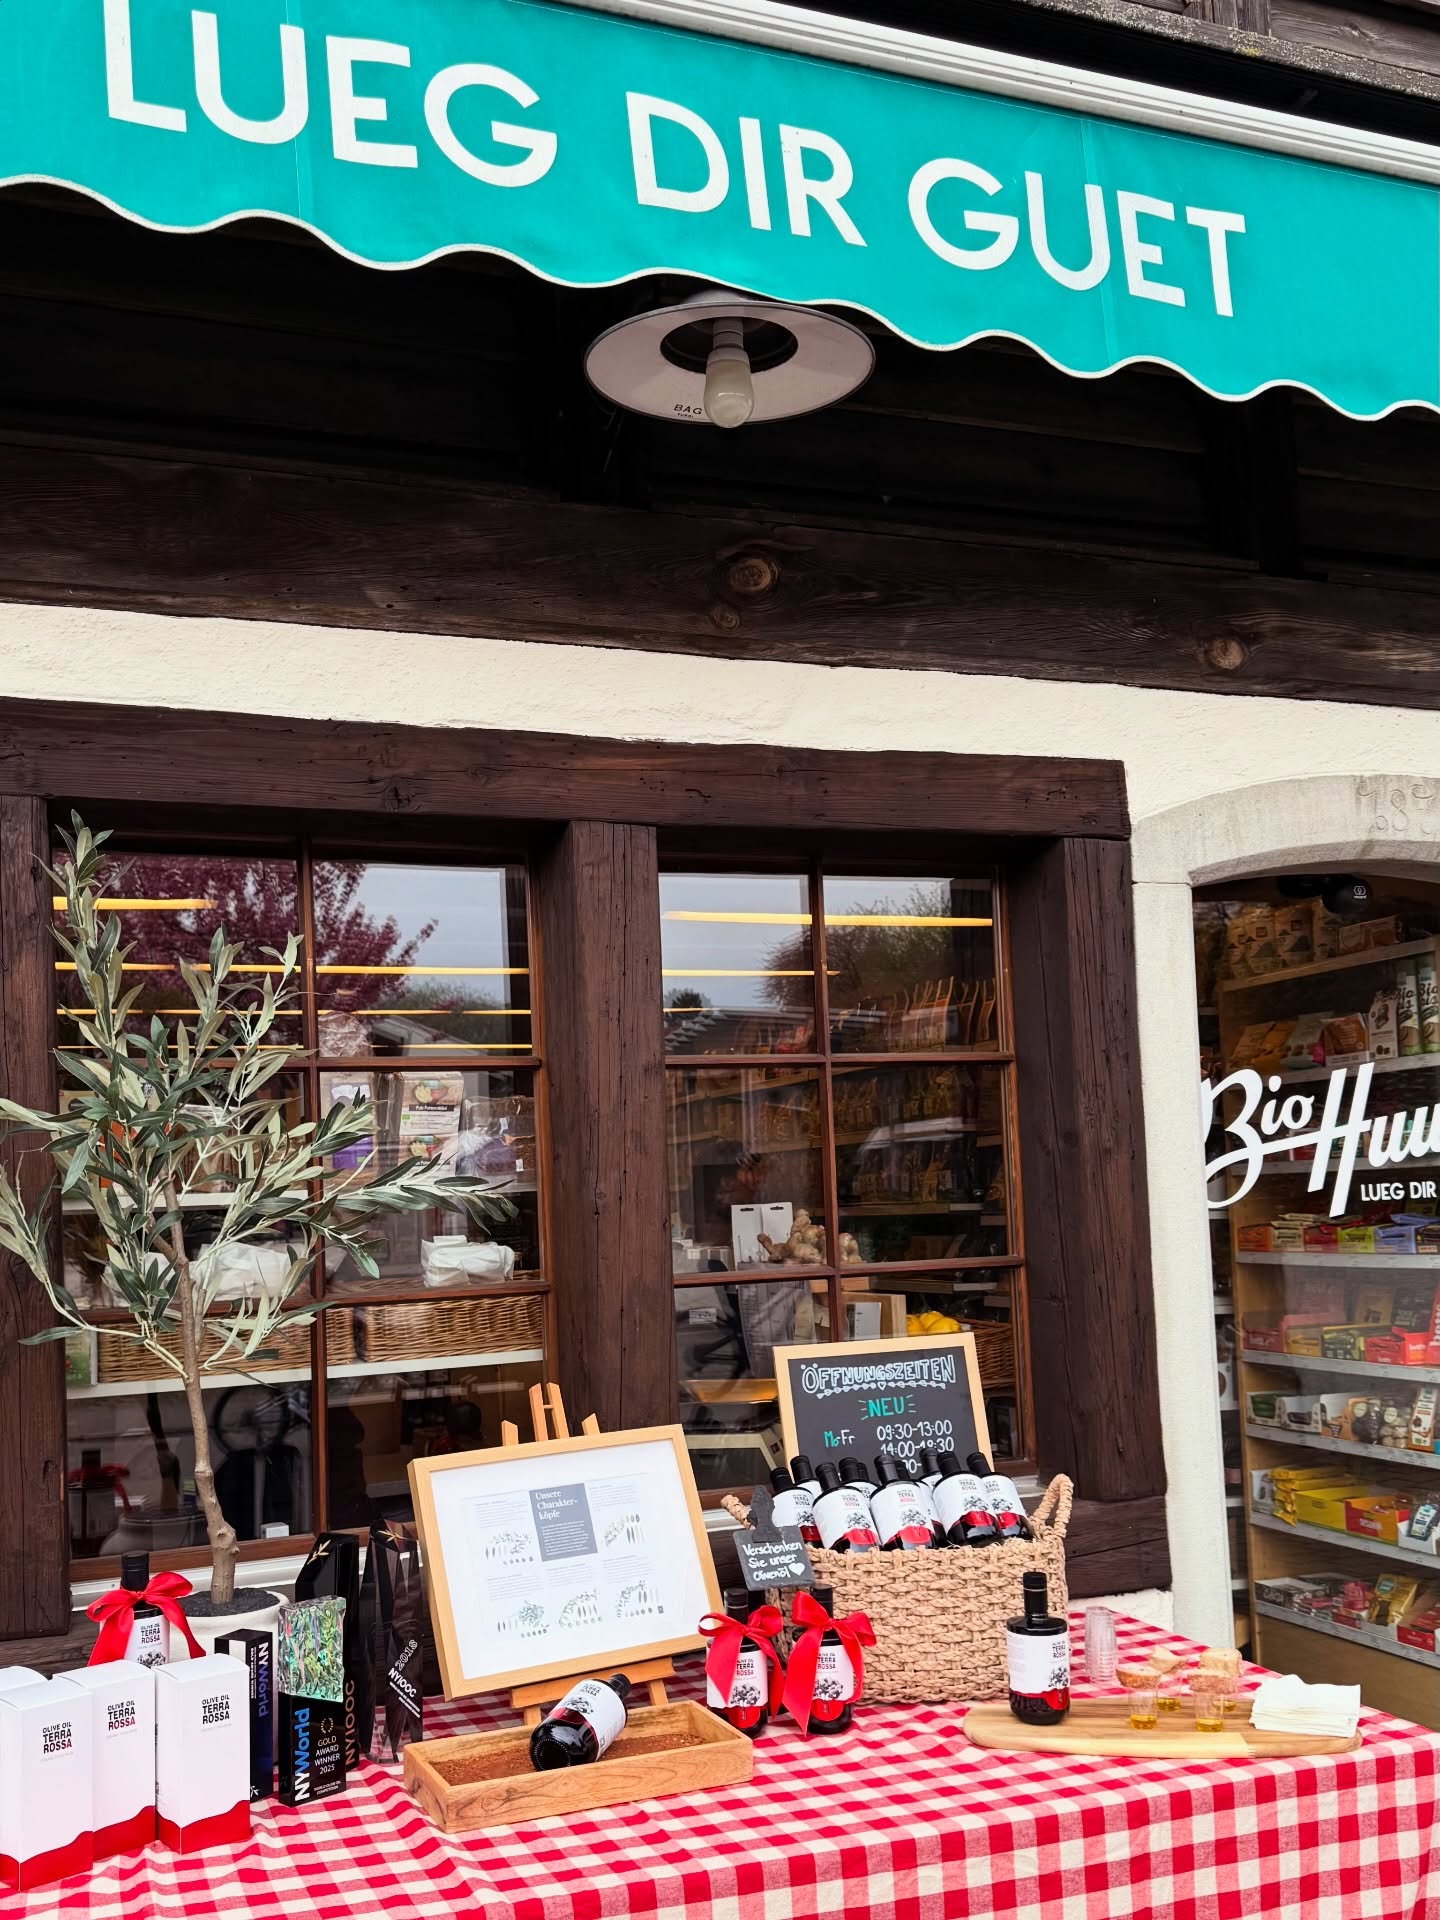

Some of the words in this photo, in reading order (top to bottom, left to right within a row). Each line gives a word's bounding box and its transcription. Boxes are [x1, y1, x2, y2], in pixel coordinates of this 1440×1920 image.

[104, 0, 558, 188] LUEG
[626, 91, 868, 248] DIR
[907, 157, 1247, 318] GUET
[673, 403, 703, 415] BAG
[1200, 1068, 1316, 1210] Bio
[1360, 1182, 1406, 1202] LUEG
[1409, 1181, 1438, 1200] DIR
[800, 1355, 957, 1394] ÖFFNUNGSZEITEN
[867, 1396, 906, 1417] NEU
[876, 1419, 953, 1441] 09:30-13:00
[535, 1490, 562, 1500] Unsere
[536, 1498, 579, 1510] Charakter-
[538, 1509, 561, 1521] köpfe
[742, 1540, 803, 1556] Verschenken
[748, 1557, 768, 1569] Sie
[769, 1554, 798, 1566] unser
[140, 1627, 160, 1637] TERRA
[141, 1634, 160, 1644] ROSSA
[258, 1641, 270, 1718] NYWorld
[388, 1667, 417, 1698] NYIOOC
[107, 1701, 125, 1711] OLIVE
[201, 1696, 219, 1705] OLIVE
[202, 1700, 230, 1715] TERRA
[107, 1706, 136, 1721] TERRA
[202, 1710, 231, 1725] ROSSA
[42, 1724, 61, 1733] OLIVE
[61, 1721, 72, 1729] OIL
[108, 1716, 136, 1731] ROSSA
[345, 1679, 355, 1766] NYIOOC
[42, 1728, 72, 1743] TERRA
[317, 1735, 337, 1747] GOLD
[43, 1738, 72, 1754] ROSSA
[315, 1744, 340, 1757] AWARD
[294, 1707, 310, 1802] NYWorld
[313, 1753, 341, 1767] WINNER
[319, 1763, 335, 1775] 2025
